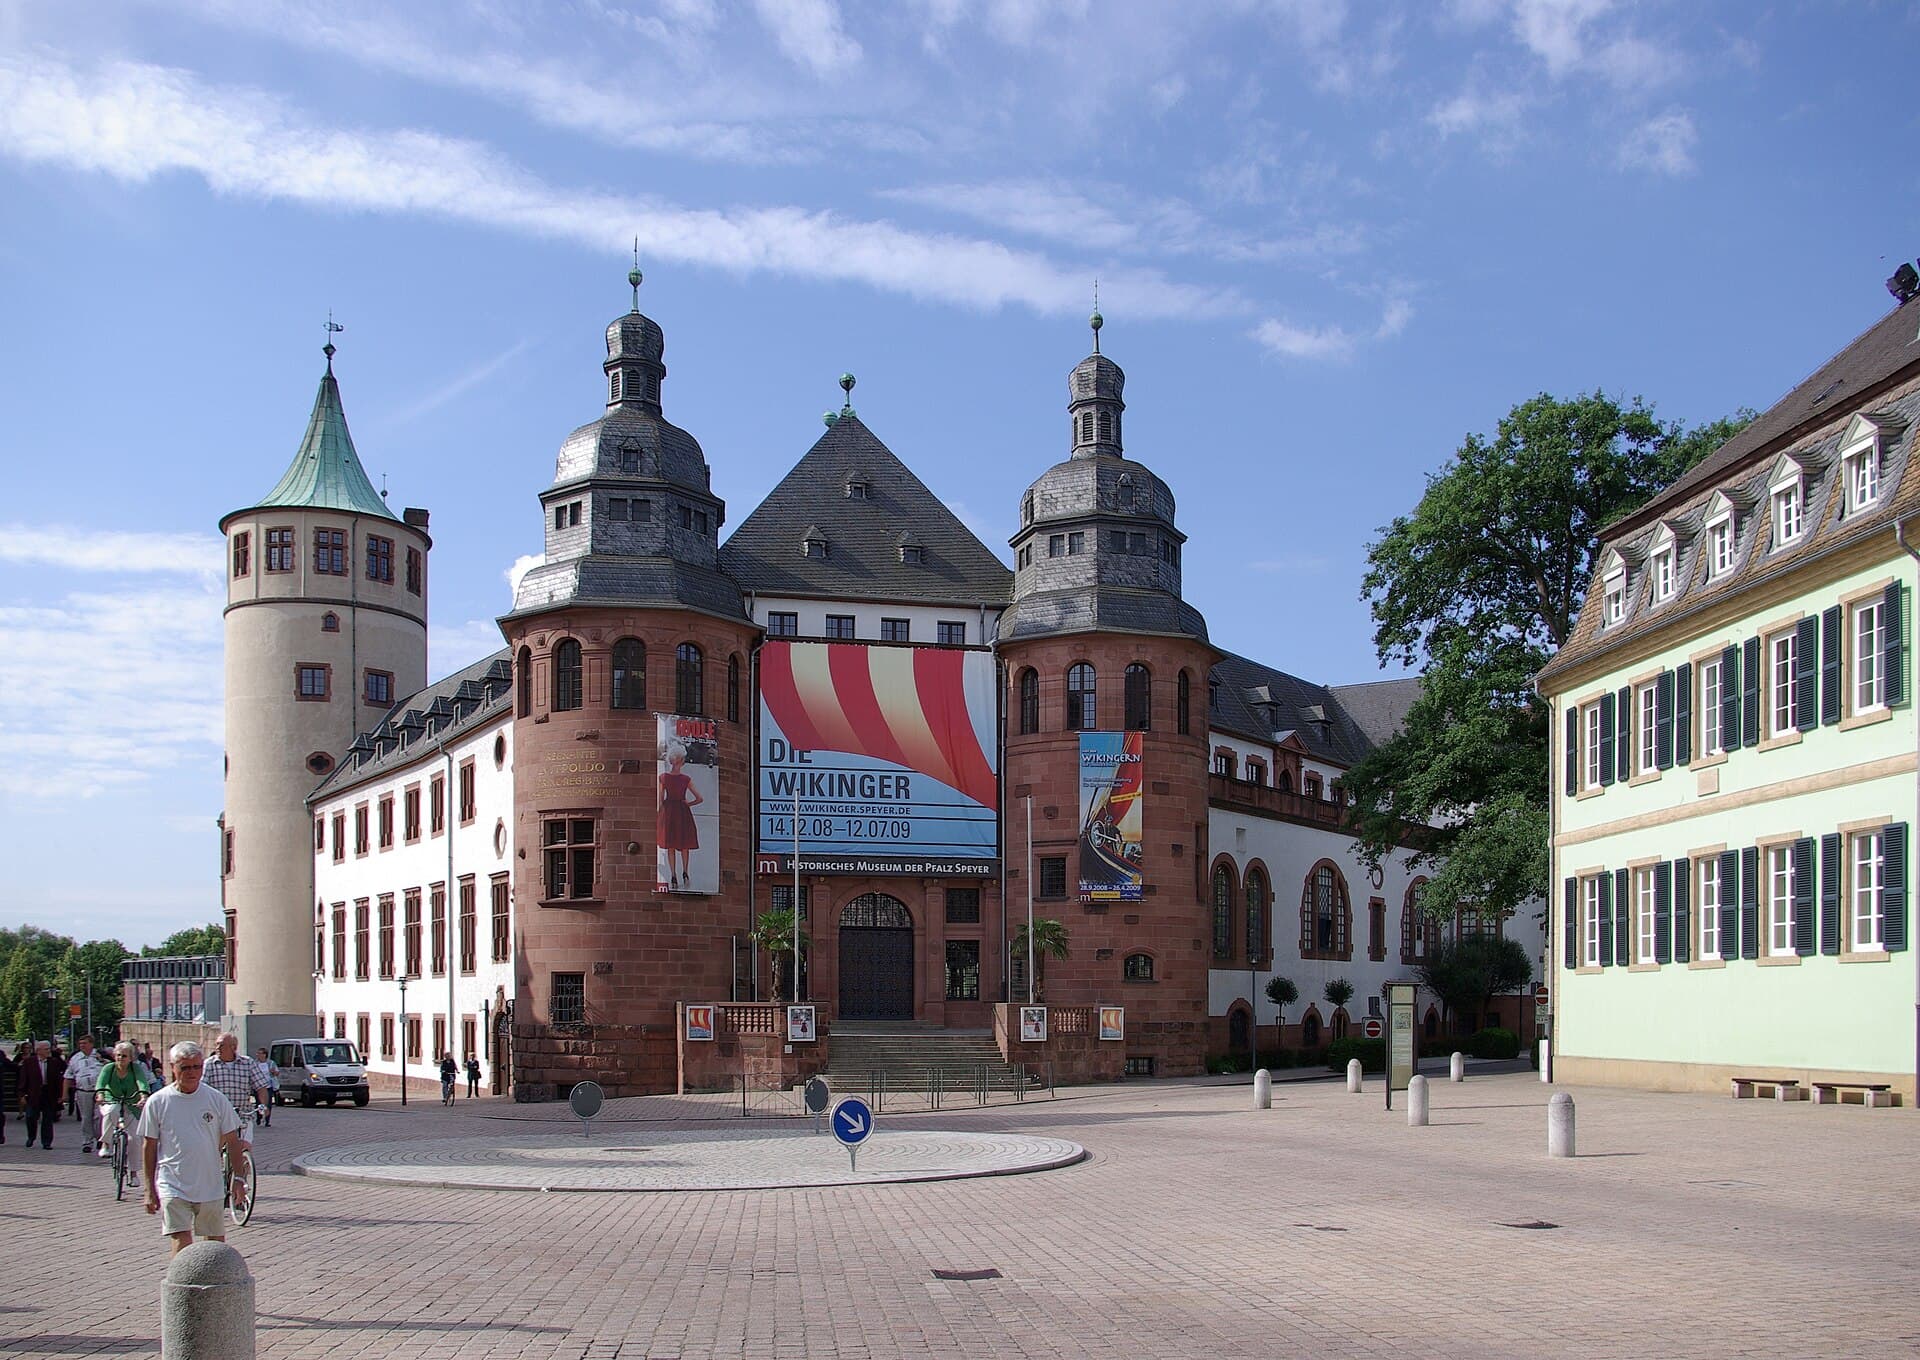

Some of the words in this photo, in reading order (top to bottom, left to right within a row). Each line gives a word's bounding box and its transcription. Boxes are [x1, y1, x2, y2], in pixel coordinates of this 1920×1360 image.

[769, 738, 812, 763] DIE
[1081, 753, 1140, 763] WIKINGERN
[768, 771, 911, 799] WIKINGER
[787, 860, 854, 871] HSTORISCHES
[856, 861, 902, 872] MUSEUM
[905, 863, 923, 873] DER
[925, 862, 953, 873] PFALZ
[955, 863, 990, 874] SPEYER
